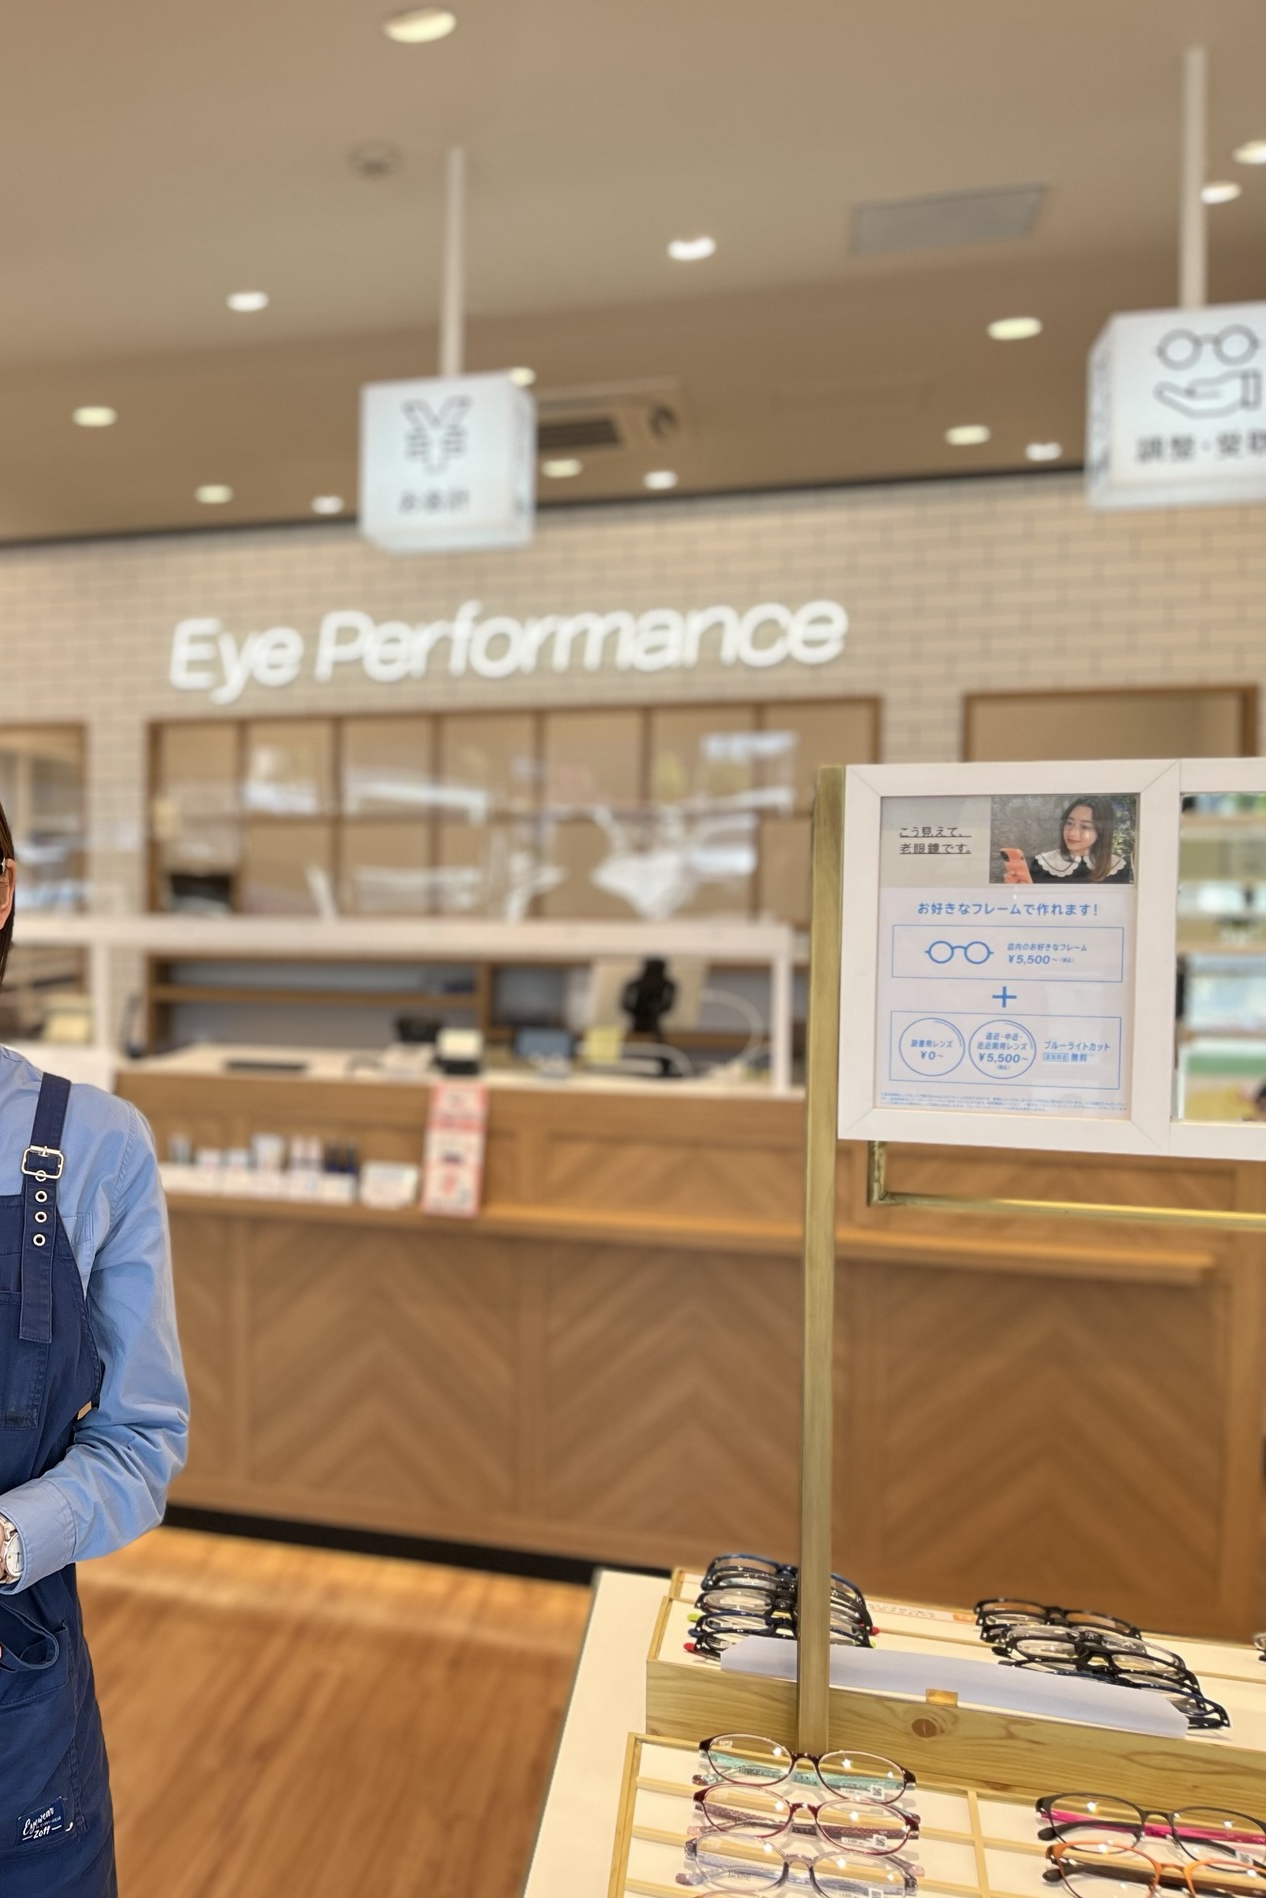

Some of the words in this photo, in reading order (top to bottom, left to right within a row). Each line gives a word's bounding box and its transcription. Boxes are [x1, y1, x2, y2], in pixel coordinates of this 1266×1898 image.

[169, 616, 304, 703] Eye
[315, 600, 848, 684] Performance
[899, 826, 964, 838] こう見えて、
[899, 843, 971, 854] 老眼鏡です。
[917, 902, 1098, 916] お好きなフレームで作れます!
[1007, 943, 1087, 952] 店内のお好きなフレーム
[1044, 1041, 1110, 1052] ブルーライトカット
